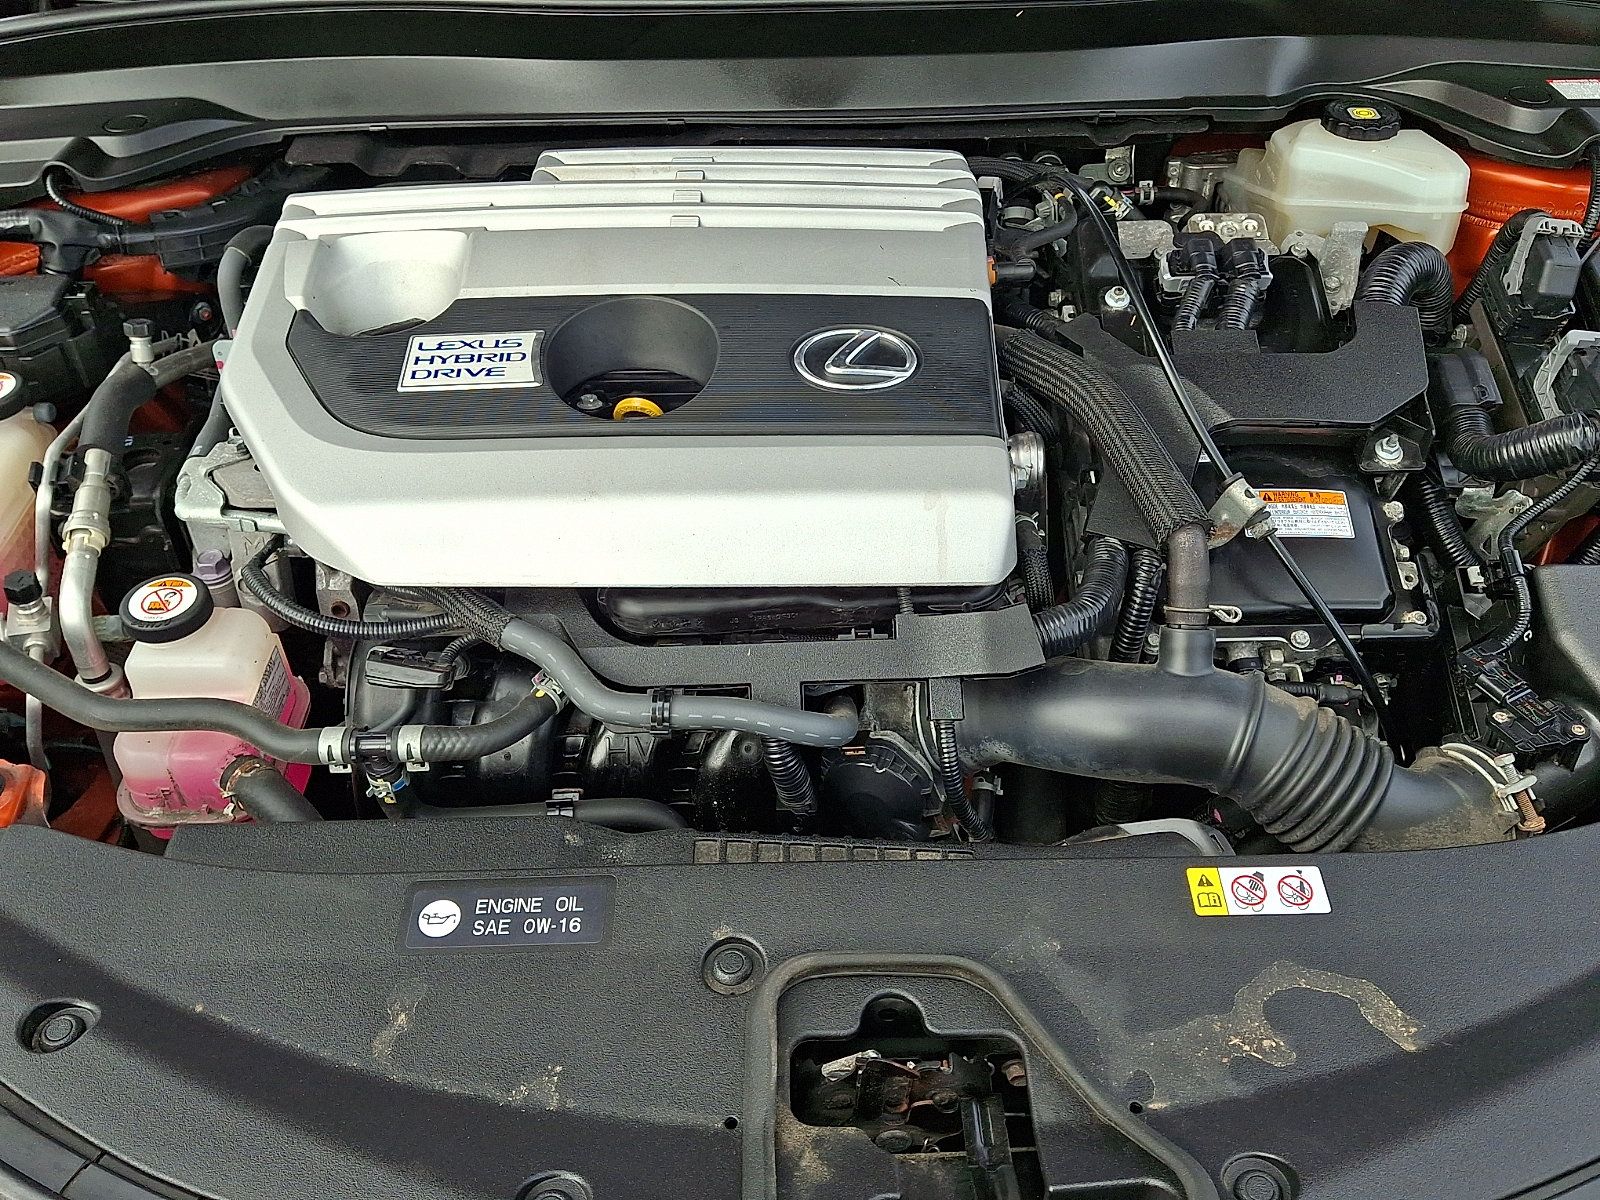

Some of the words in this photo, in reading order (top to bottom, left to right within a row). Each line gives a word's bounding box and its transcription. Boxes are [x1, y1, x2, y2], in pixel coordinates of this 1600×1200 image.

[418, 338, 523, 351] LEXUS
[413, 351, 527, 365] HYBRID
[410, 366, 507, 379] DRIVE
[475, 897, 543, 914] ENGINE
[555, 896, 584, 912] OIL
[472, 919, 511, 936] SAE
[523, 917, 582, 934] 0W-16
